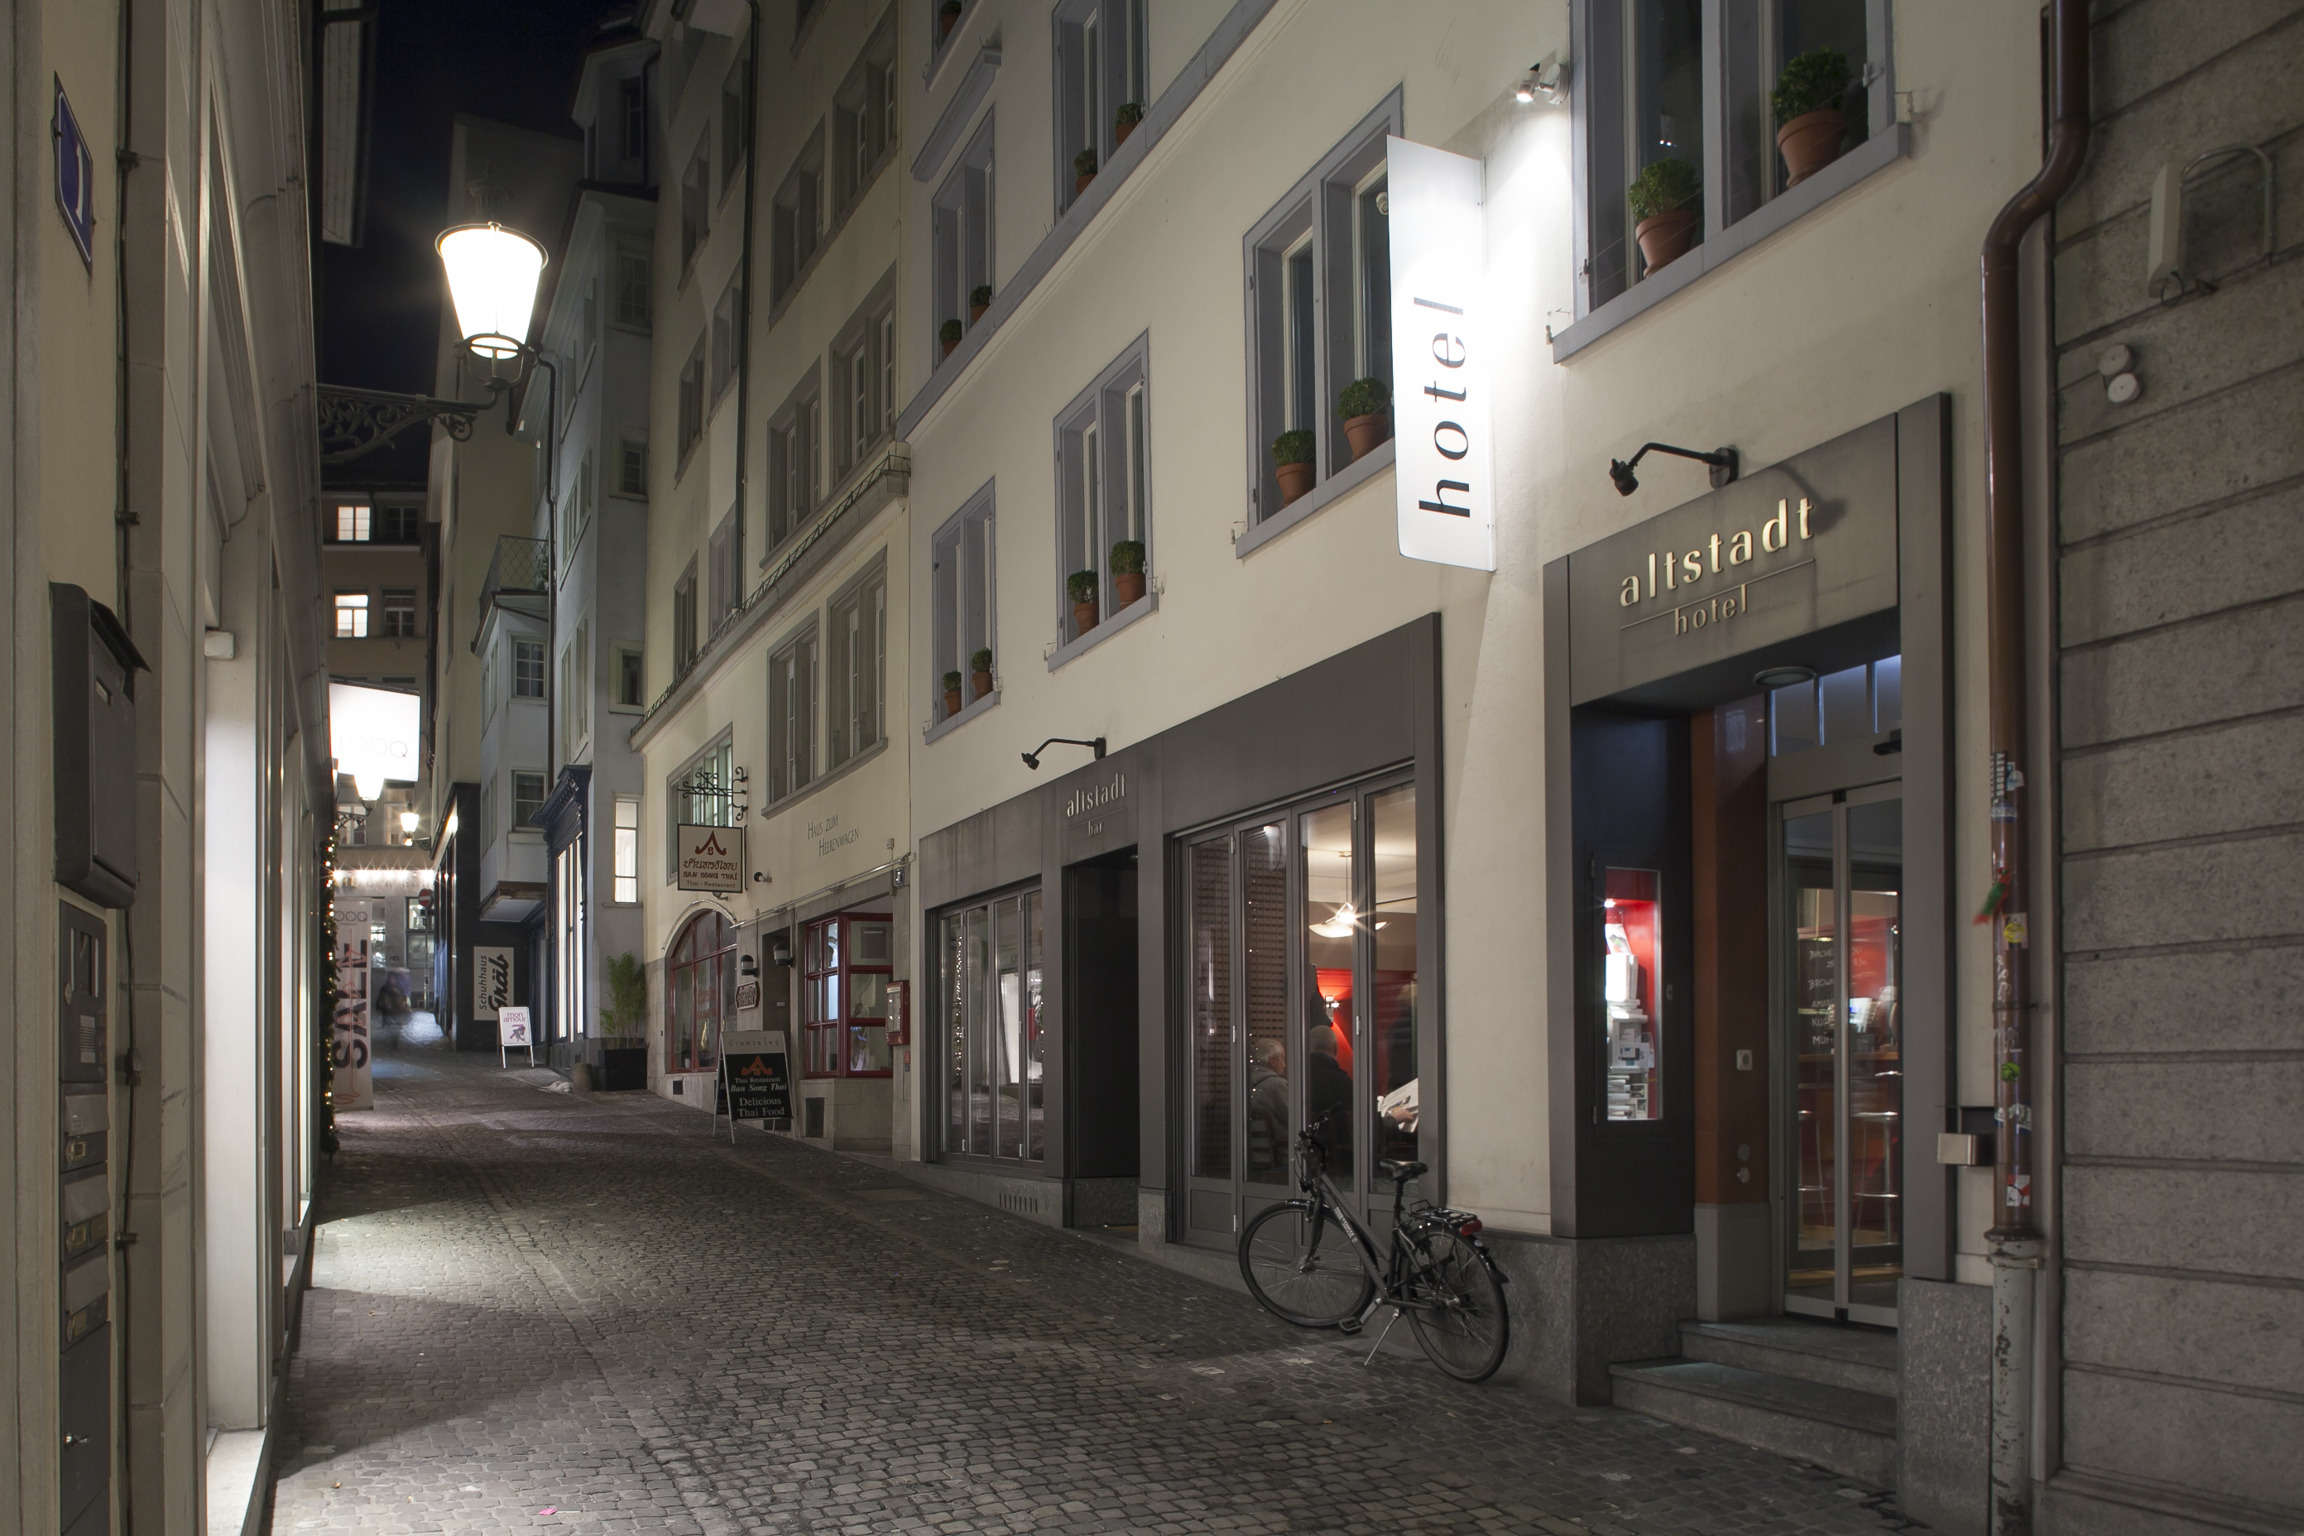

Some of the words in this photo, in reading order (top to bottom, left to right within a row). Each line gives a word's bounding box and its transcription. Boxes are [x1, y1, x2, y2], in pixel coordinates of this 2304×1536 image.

[1414, 297, 1471, 519] hotel
[1619, 497, 1815, 608] altstadt
[1674, 584, 1749, 636] hotel
[1066, 772, 1126, 817] altstadt
[1088, 820, 1103, 835] bar
[683, 871, 698, 879] BAN
[333, 939, 368, 1069] SALE
[479, 955, 488, 1011] Schuhhaus
[488, 953, 509, 1012] Gräb
[738, 1107, 759, 1117] Thai
[762, 1107, 785, 1117] Food
[739, 1096, 782, 1106] Delicious
